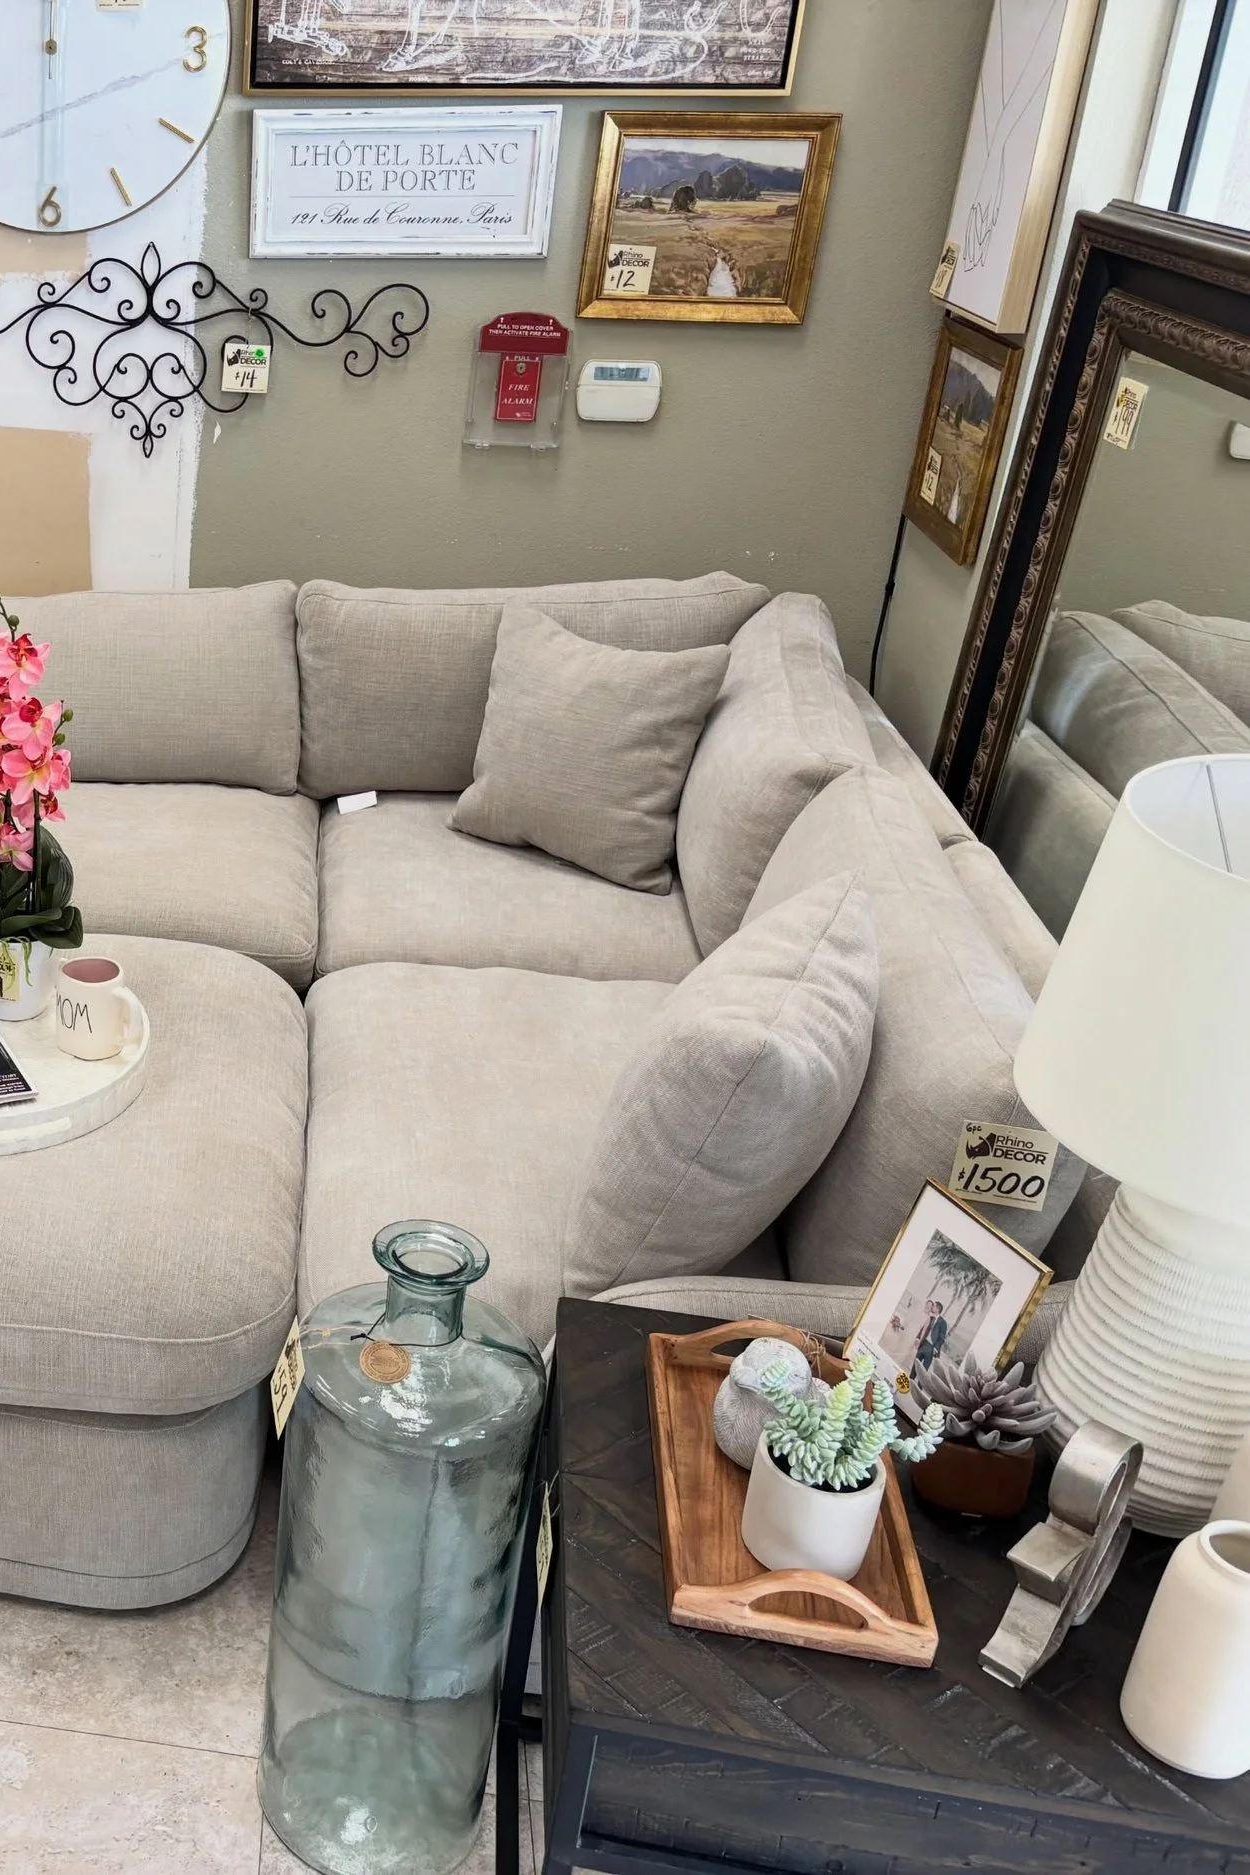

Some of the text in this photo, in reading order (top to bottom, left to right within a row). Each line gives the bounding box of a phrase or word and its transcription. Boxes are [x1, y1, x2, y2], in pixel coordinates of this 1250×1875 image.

[182, 25, 208, 73] 3
[418, 142, 519, 166] BLANC
[335, 168, 476, 192] DE PORTE
[38, 186, 62, 227] 6
[291, 212, 318, 225] 121
[320, 202, 361, 225] Rue
[363, 208, 380, 225] de
[466, 201, 513, 225] Paris
[621, 259, 650, 267] DECOR
[623, 250, 643, 259] Rhino
[240, 358, 267, 366] DECOR
[508, 383, 531, 391] FIRE
[996, 1135, 1034, 1149] Rhino
[993, 1148, 1047, 1165] DECOR
[957, 1163, 1045, 1198] $1500
